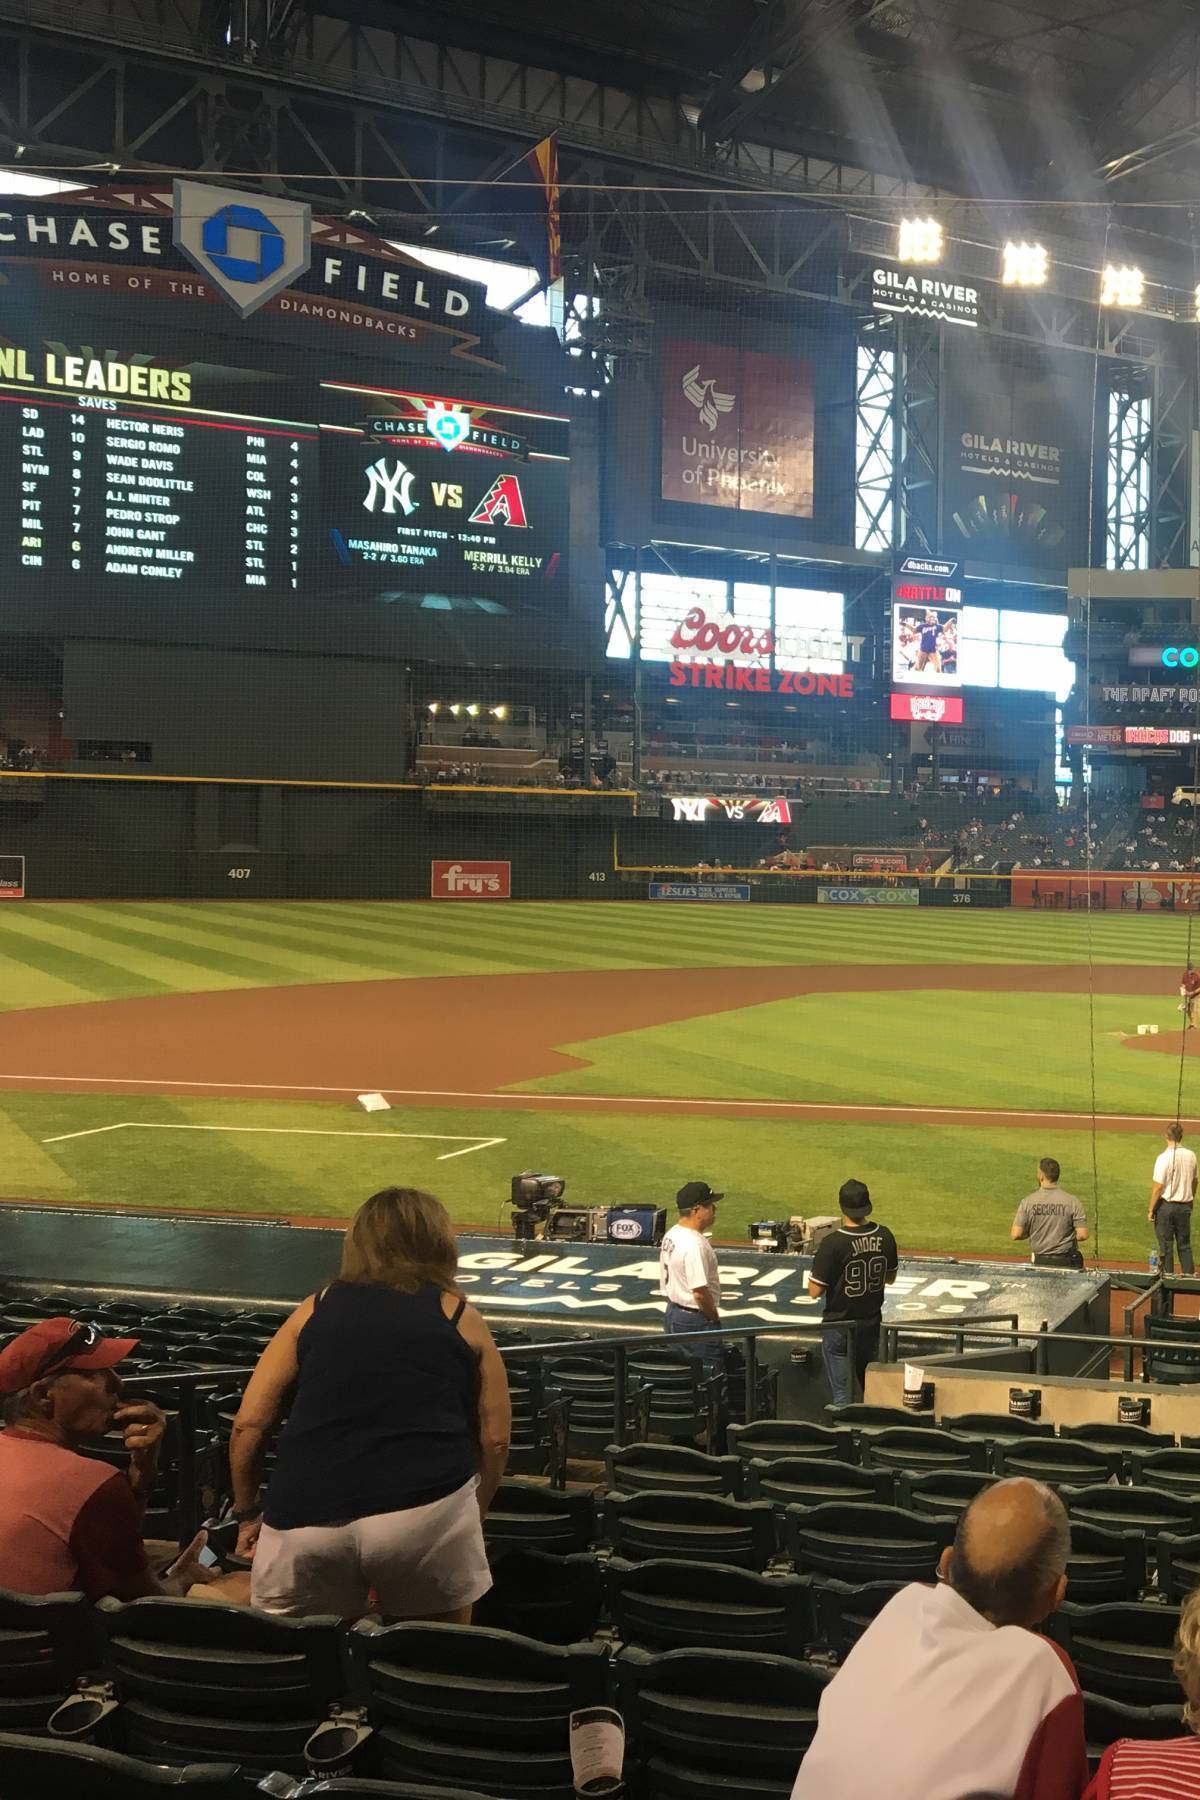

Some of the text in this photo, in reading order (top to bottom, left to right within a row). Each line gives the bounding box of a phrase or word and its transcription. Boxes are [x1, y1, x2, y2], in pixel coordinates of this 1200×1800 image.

[324, 257, 470, 317] FIELD
[873, 269, 977, 304] GILA RIVER
[52, 270, 417, 338] HOME OF THE DIAMONDBACKS
[873, 288, 978, 315] HOTELS CASINOS
[0, 347, 192, 402] NL LEADERS
[78, 396, 118, 411] SAVES
[23, 408, 85, 425] SD 14
[22, 427, 85, 443] LAD 10
[106, 418, 298, 452] HECTOR NERIS PHI 4
[374, 422, 520, 449] CHASE FIELD
[22, 445, 81, 461] STL 9
[106, 436, 298, 469] SERGIO ROMO MIA 4
[682, 436, 781, 467] University
[961, 432, 1060, 461] GILA RIVER
[22, 464, 81, 479] NYM 8
[106, 454, 298, 486] WADE DAVIS COL 4
[961, 452, 1060, 473] HOTELS CASINOS
[682, 465, 704, 485] of
[22, 482, 80, 496] SF 7
[106, 473, 298, 503] SEAN DOOLITTLE WSH 3
[432, 482, 463, 508] VS
[22, 500, 80, 515] PIT 7
[106, 491, 298, 520] A.J. MINTER ATL 3
[22, 518, 80, 533] MIL 7
[106, 508, 298, 537] PEDRO STROP CHC 3
[22, 536, 80, 551] ARI 6
[106, 526, 298, 555] JOHN GANT STL 2
[397, 526, 496, 544] FIRST PITCH 12:40 PM
[106, 544, 297, 571] ANDREW MILLER STL 1
[348, 540, 438, 557] MASAHIRO TANAKA
[22, 555, 80, 569] CIN 6
[362, 552, 424, 565] 2-2 3.60 ERA
[464, 550, 542, 568] MERRILL KELLY
[907, 560, 950, 574] dbacks.com
[106, 562, 297, 588] ADAM CONLEY MIA 1
[472, 562, 530, 576] 2-2 3.94 ERA
[670, 606, 776, 655] Coors
[669, 660, 854, 698] STRIKE ZONE
[1102, 688, 1128, 702] THE
[1170, 730, 1190, 743] DOG
[724, 806, 744, 820] VS
[228, 868, 251, 880] 407
[588, 872, 606, 882] 413
[829, 890, 860, 900] COX
[952, 894, 971, 903] 376
[1032, 1204, 1066, 1217] SECURITY
[616, 1224, 634, 1232] FOX
[852, 1237, 883, 1257] JUDGE
[457, 1252, 661, 1280] GILA
[454, 1274, 623, 1292] OTELS
[844, 1256, 888, 1298] 99
